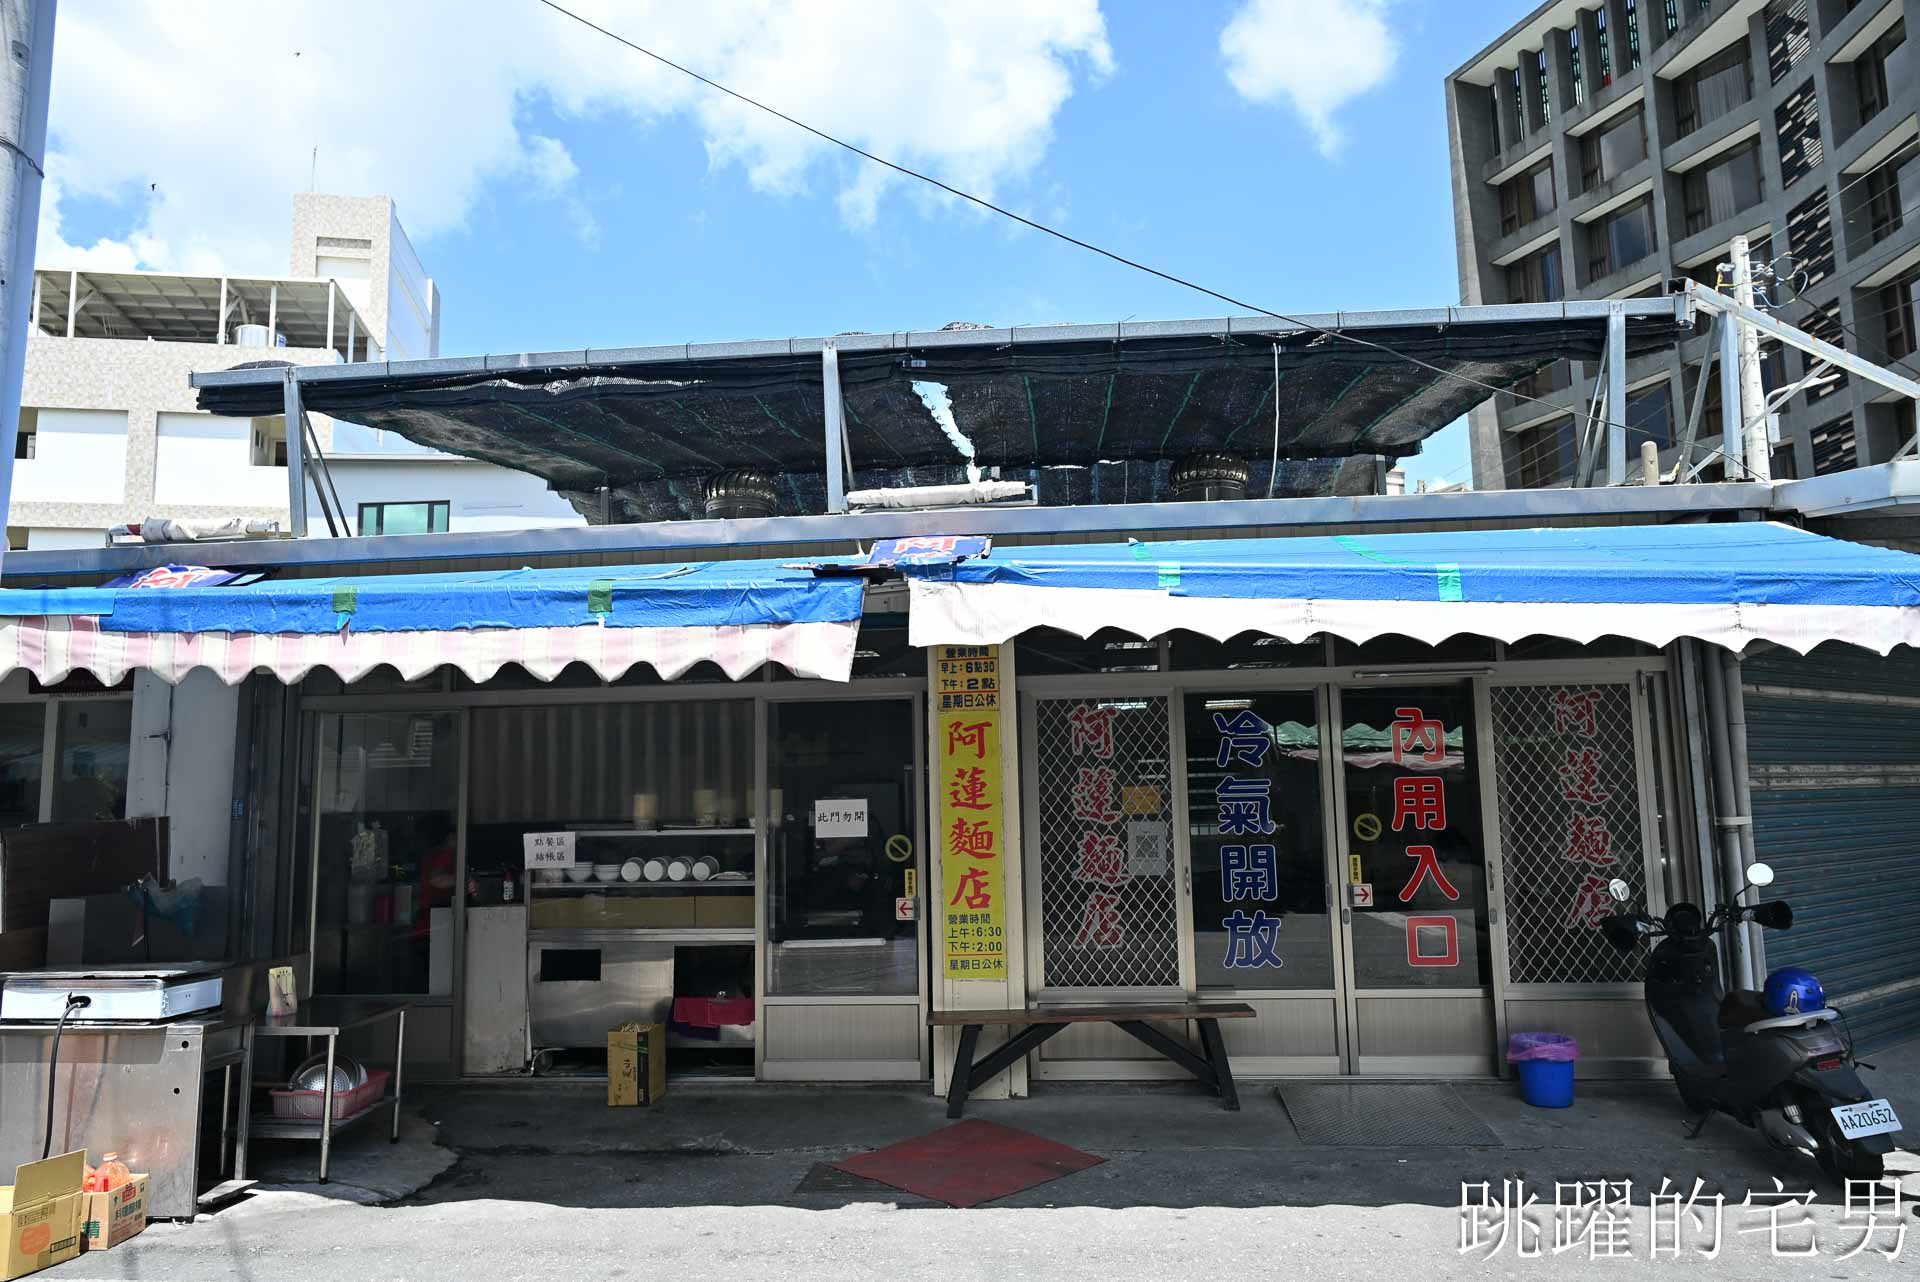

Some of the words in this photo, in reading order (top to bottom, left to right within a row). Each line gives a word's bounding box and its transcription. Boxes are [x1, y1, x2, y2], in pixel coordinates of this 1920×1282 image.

[945, 646, 989, 658] 營業時間
[942, 693, 997, 709] 星期日公休
[817, 810, 865, 823] 此門勿開
[948, 719, 998, 911] 阿蓮麵店
[1212, 710, 1283, 969] 冷氣開放
[1391, 707, 1460, 967] 內用入口
[948, 913, 991, 925] 營業時間
[948, 927, 1002, 939] 上午:6:30
[948, 941, 1002, 953] 下午:2:00
[950, 958, 1003, 970] 星期日公休
